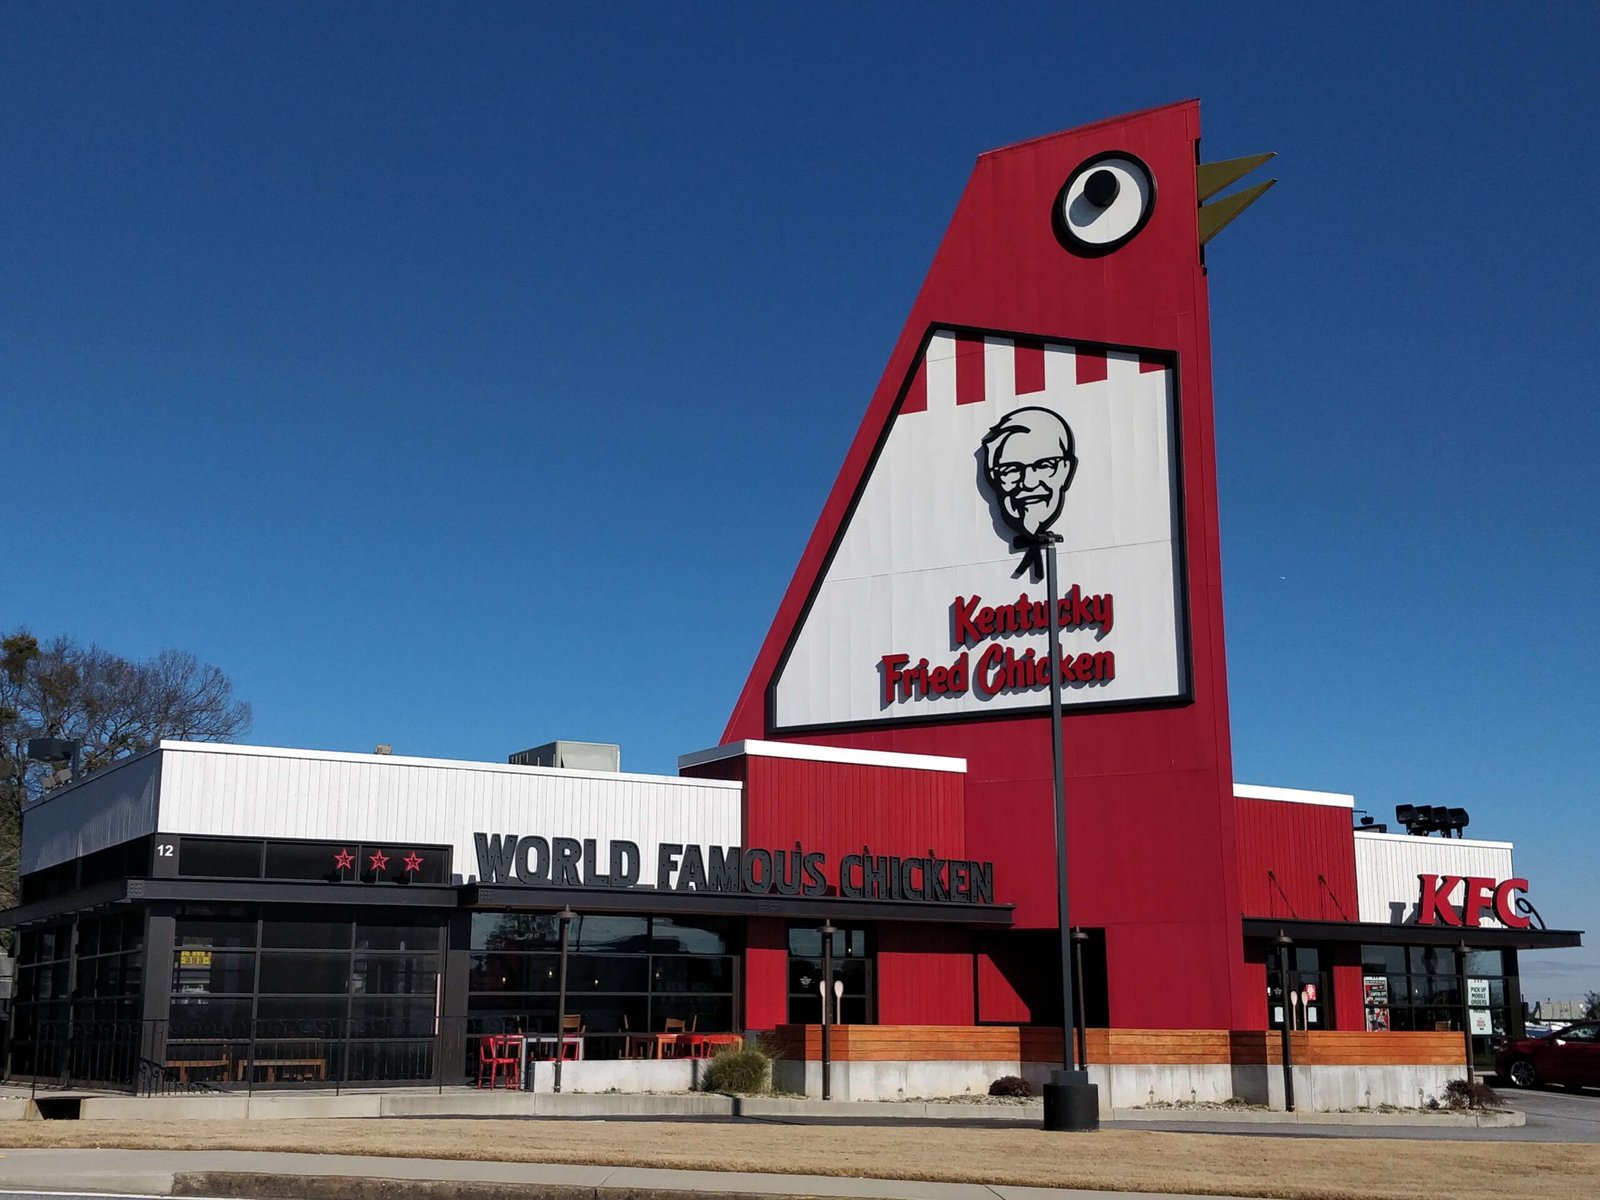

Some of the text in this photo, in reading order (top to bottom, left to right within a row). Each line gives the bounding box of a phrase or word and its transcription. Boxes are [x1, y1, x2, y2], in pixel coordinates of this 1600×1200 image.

[955, 584, 1114, 644] Kentucky
[881, 643, 1116, 702] Fried Chicken
[157, 844, 174, 857] 12
[473, 832, 994, 904] WORLD FAMOUS CHICKEN
[1417, 873, 1531, 929] KFC
